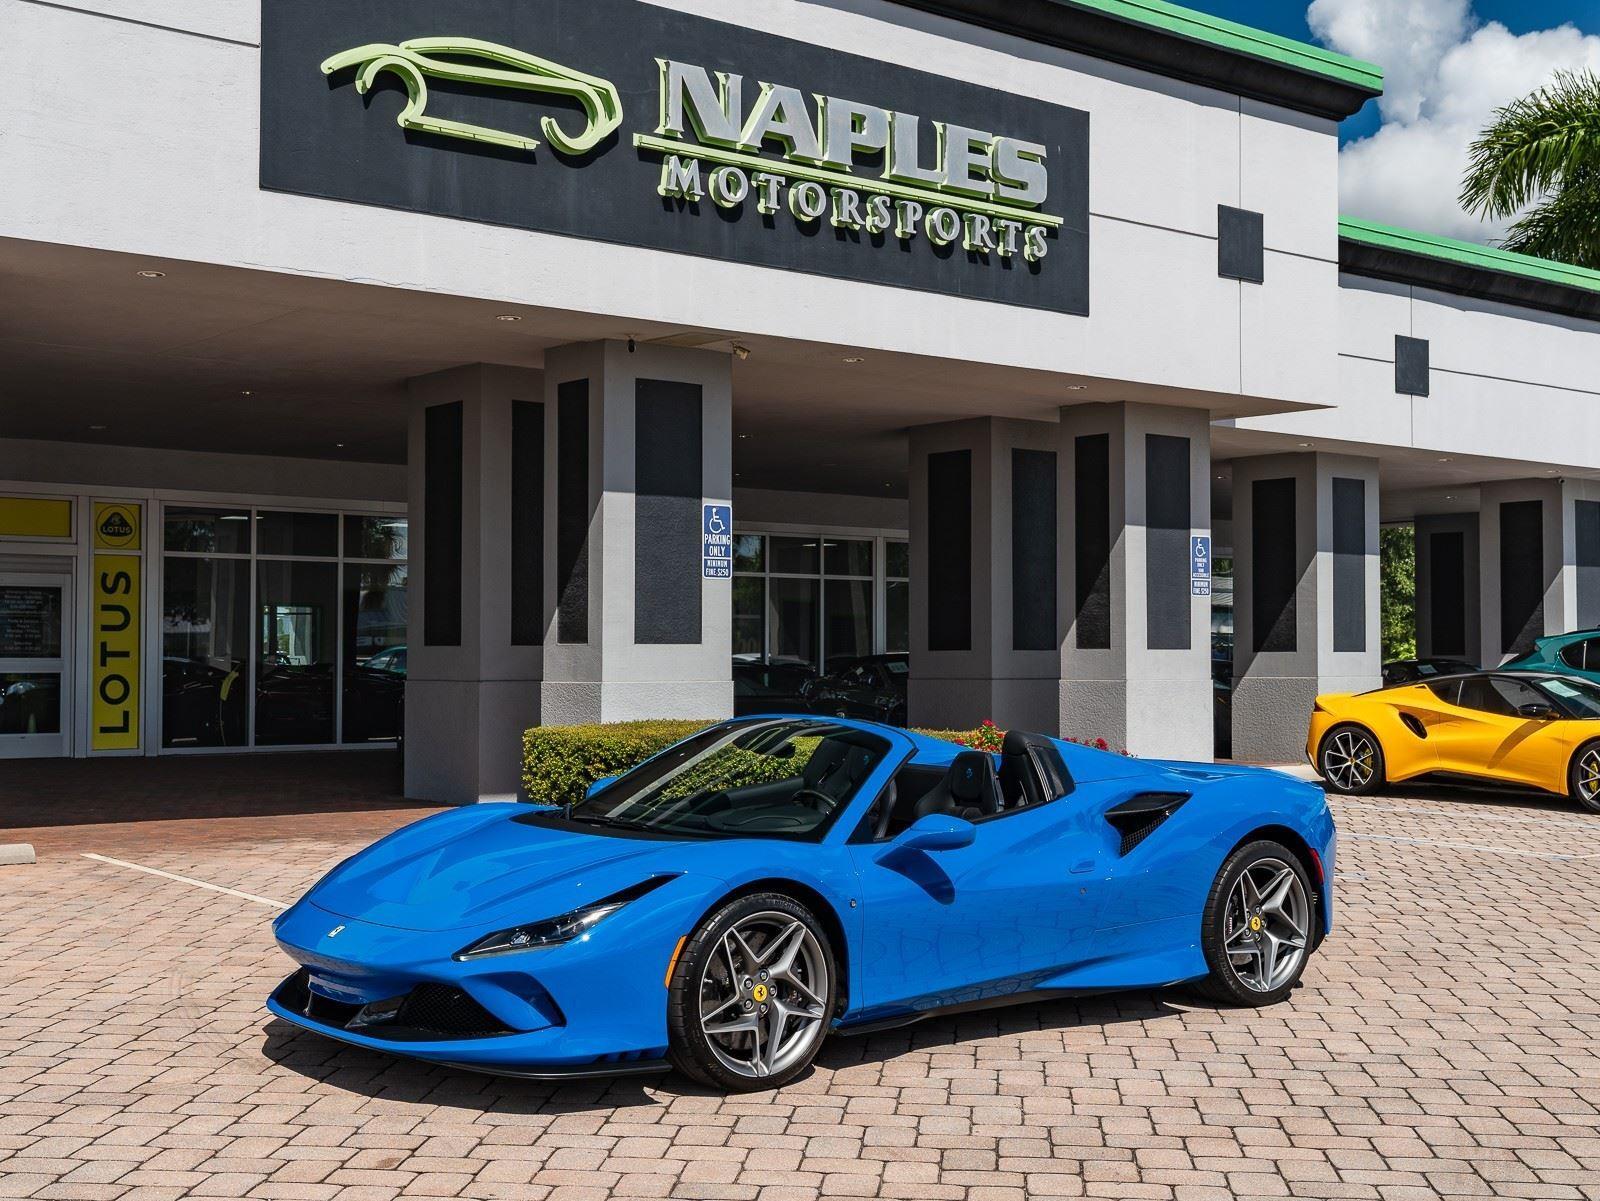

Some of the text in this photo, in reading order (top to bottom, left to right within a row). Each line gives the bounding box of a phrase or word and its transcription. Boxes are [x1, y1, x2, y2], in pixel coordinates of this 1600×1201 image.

[655, 58, 1047, 207] NAPLES
[657, 154, 1047, 262] MOTORSPORTS
[102, 526, 131, 534] LOTUS
[704, 534, 730, 545] PARKING
[709, 546, 725, 556] ONLY
[99, 571, 131, 733] LOTUS
